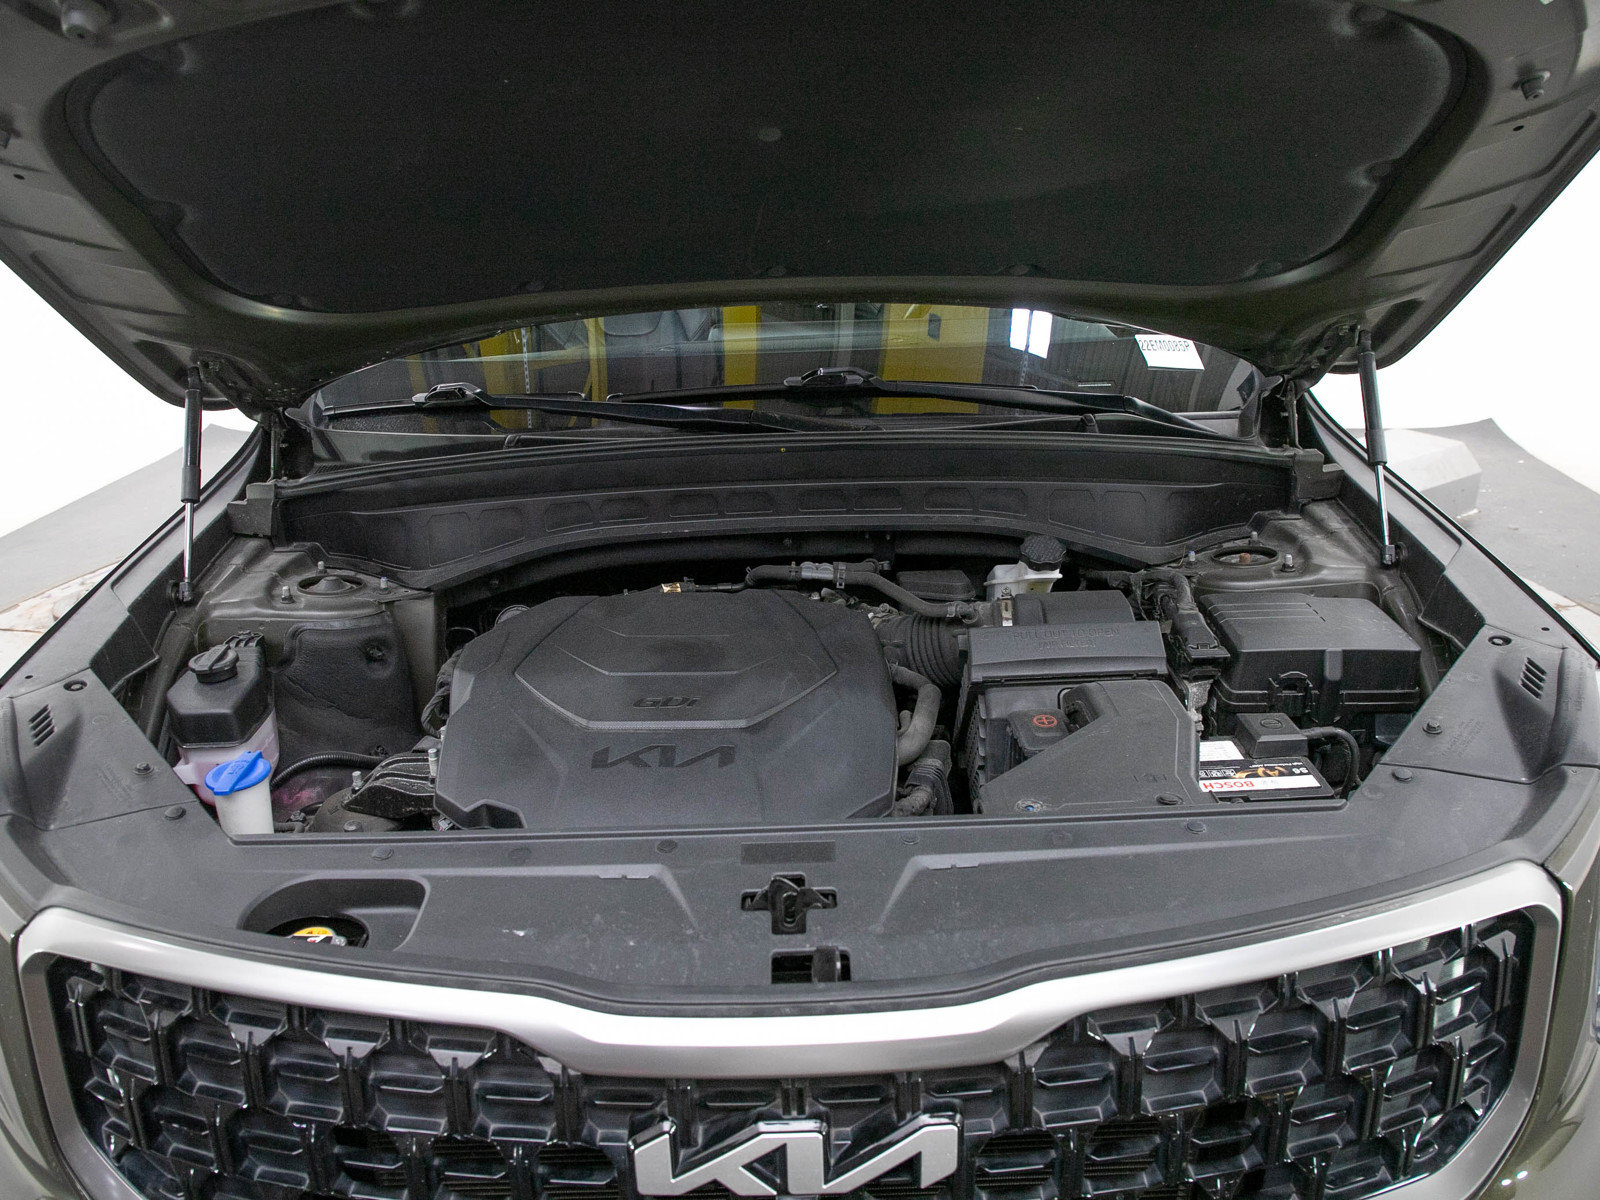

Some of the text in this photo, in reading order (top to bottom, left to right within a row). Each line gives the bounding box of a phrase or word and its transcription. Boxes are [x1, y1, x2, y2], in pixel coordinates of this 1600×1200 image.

[591, 744, 736, 769] KIA
[1202, 780, 1255, 789] BOSCH
[629, 1116, 961, 1196] KIA
